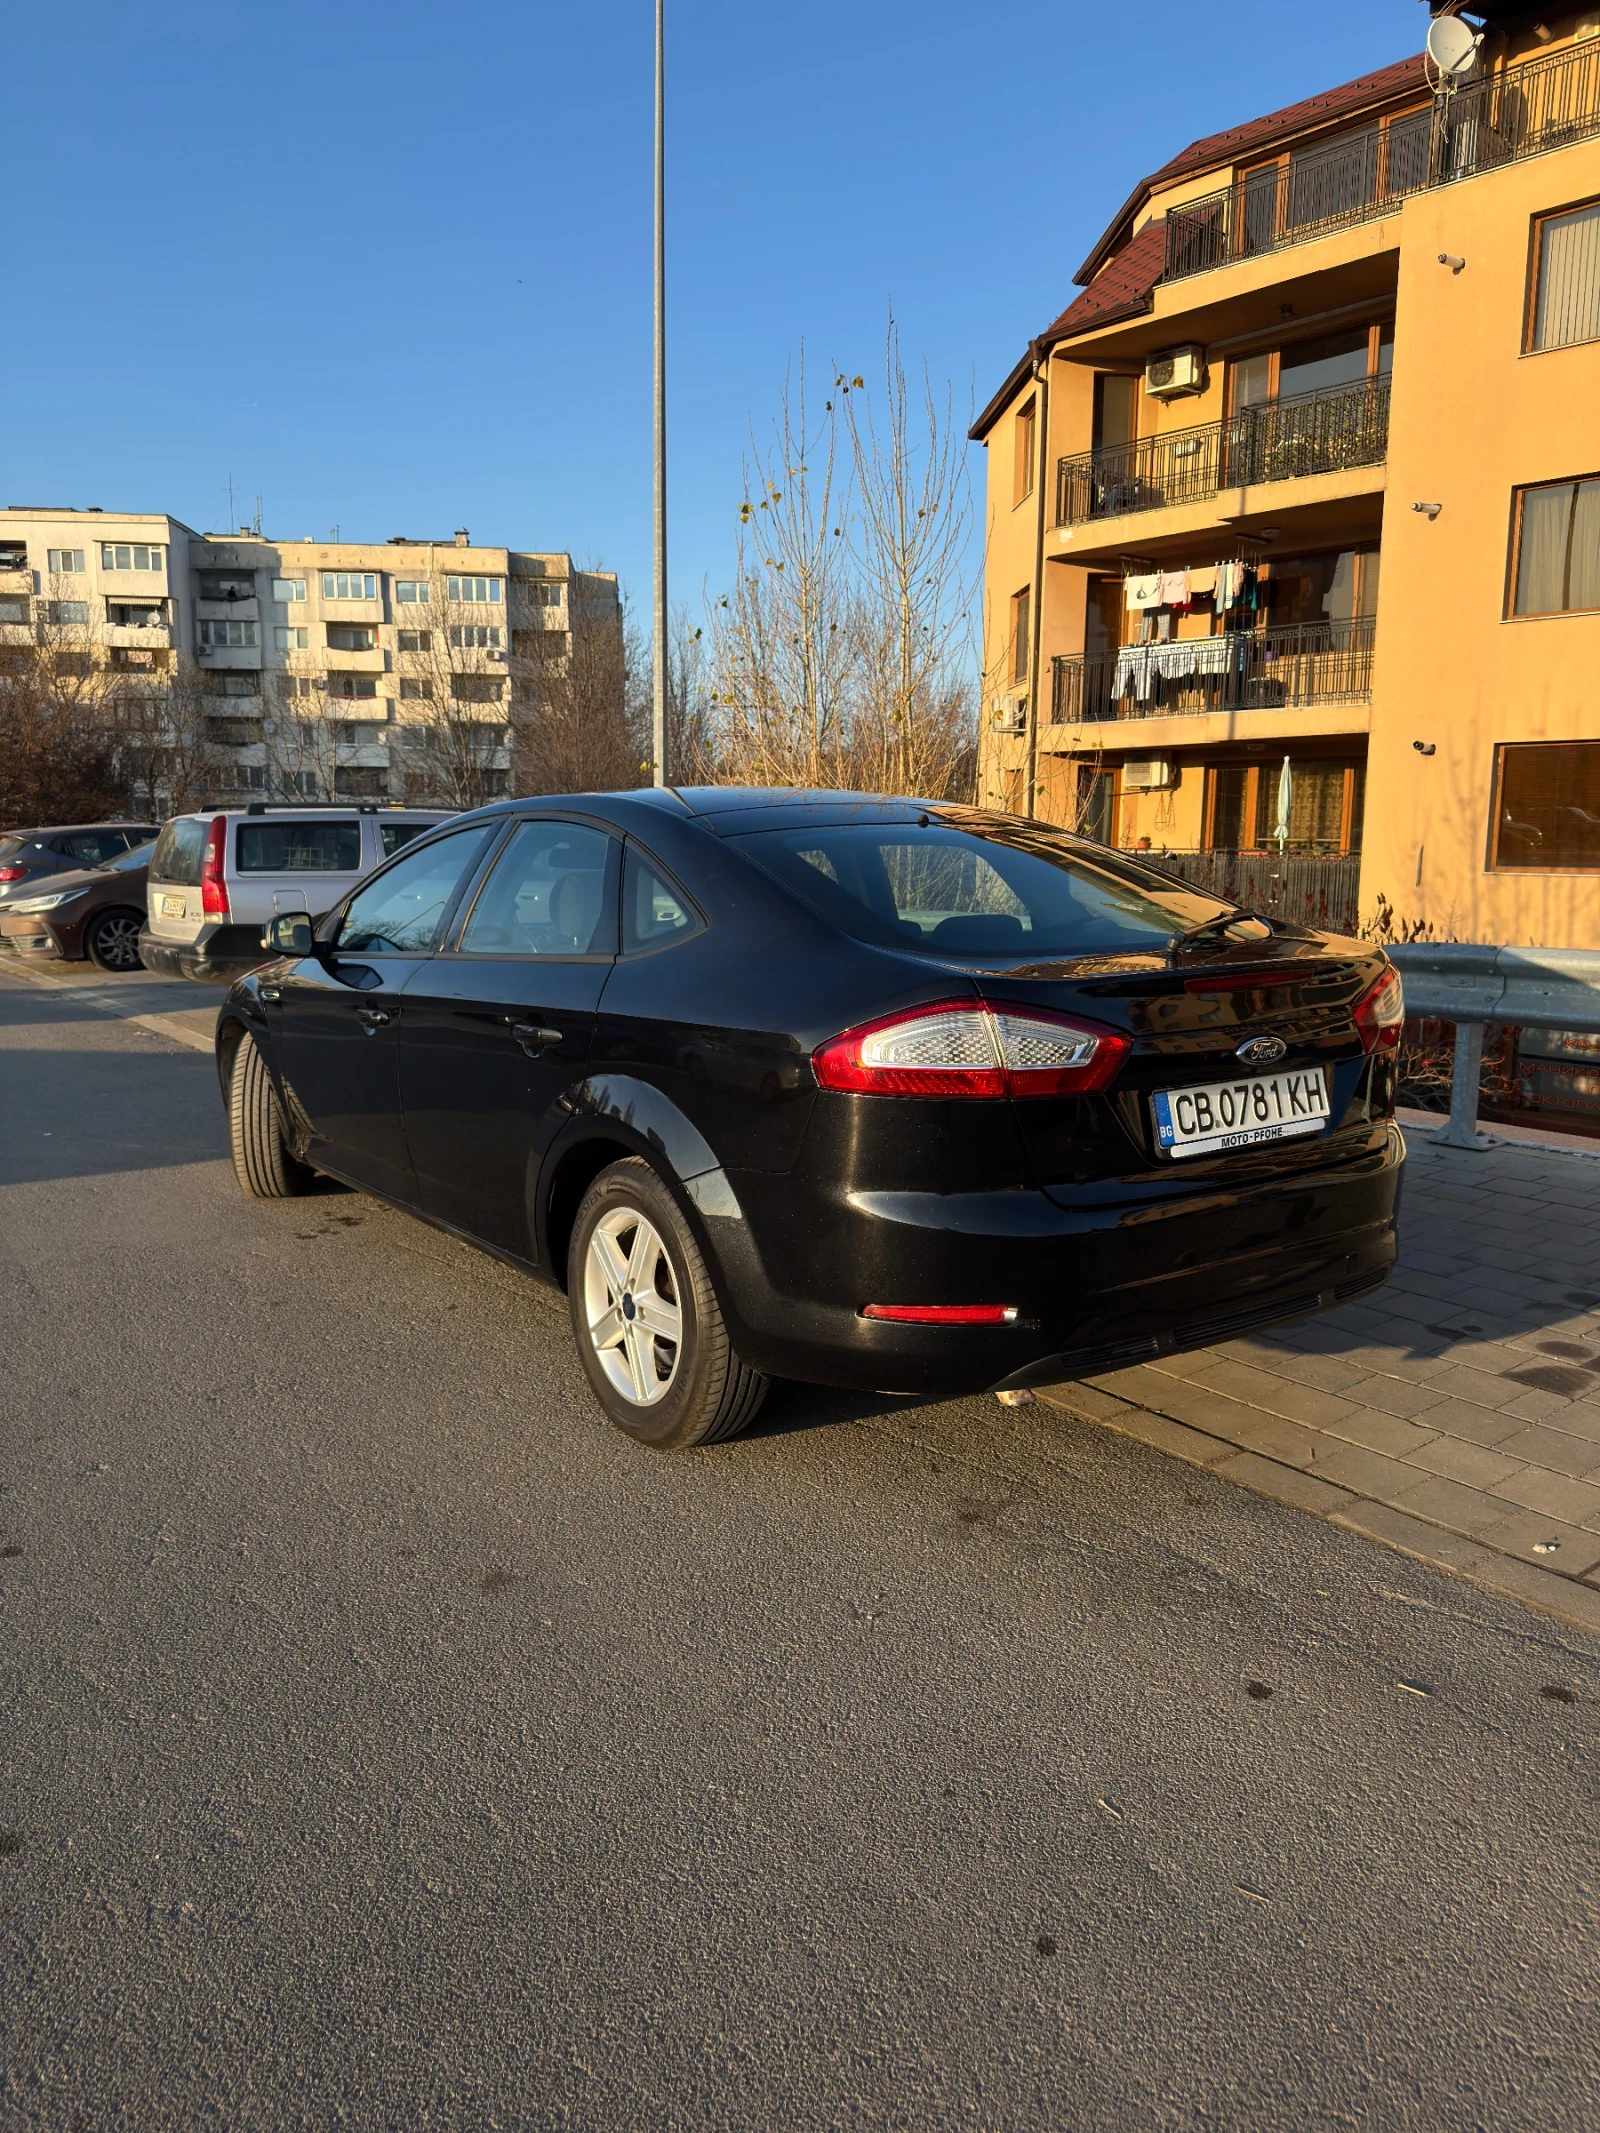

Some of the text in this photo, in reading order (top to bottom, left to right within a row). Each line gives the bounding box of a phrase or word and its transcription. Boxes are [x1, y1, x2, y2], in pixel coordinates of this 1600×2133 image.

[1251, 1042, 1278, 1060] Ford
[1525, 1093, 1600, 1111] ОКТОПЛ
[1160, 1125, 1173, 1138] BG
[1221, 1127, 1283, 1148] MOTO-PFOHE
